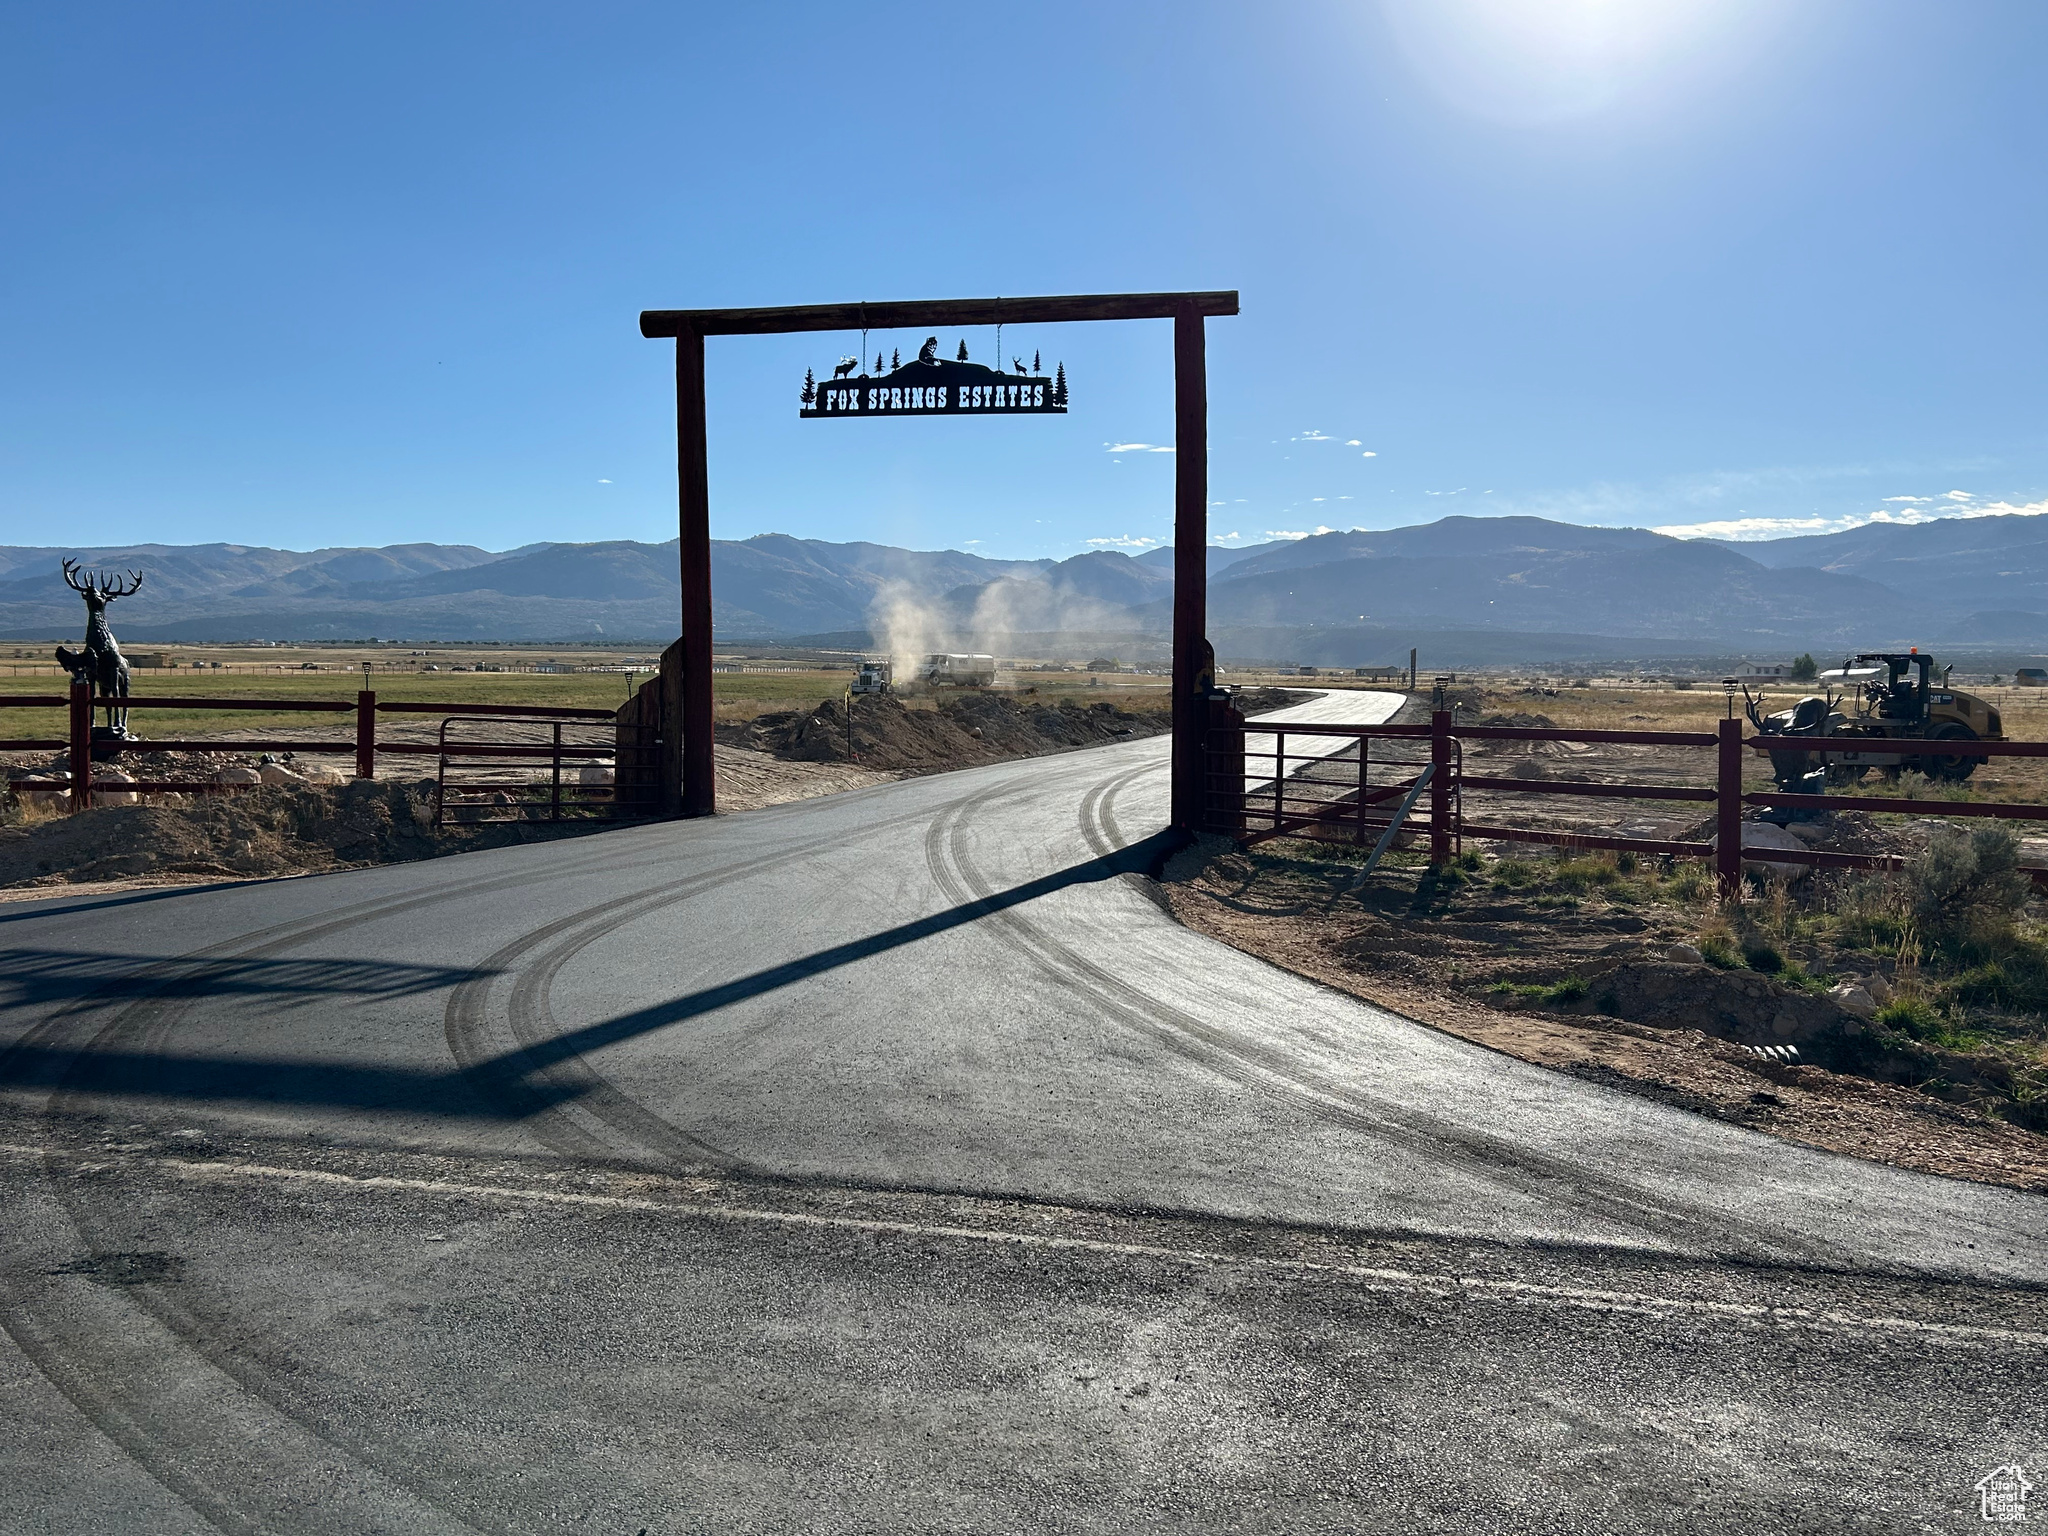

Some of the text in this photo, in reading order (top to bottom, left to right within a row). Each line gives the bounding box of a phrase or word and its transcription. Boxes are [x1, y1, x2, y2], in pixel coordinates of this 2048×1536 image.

[826, 384, 1044, 411] FOX SPRINGS ESTATES
[1929, 694, 1942, 704] CAT
